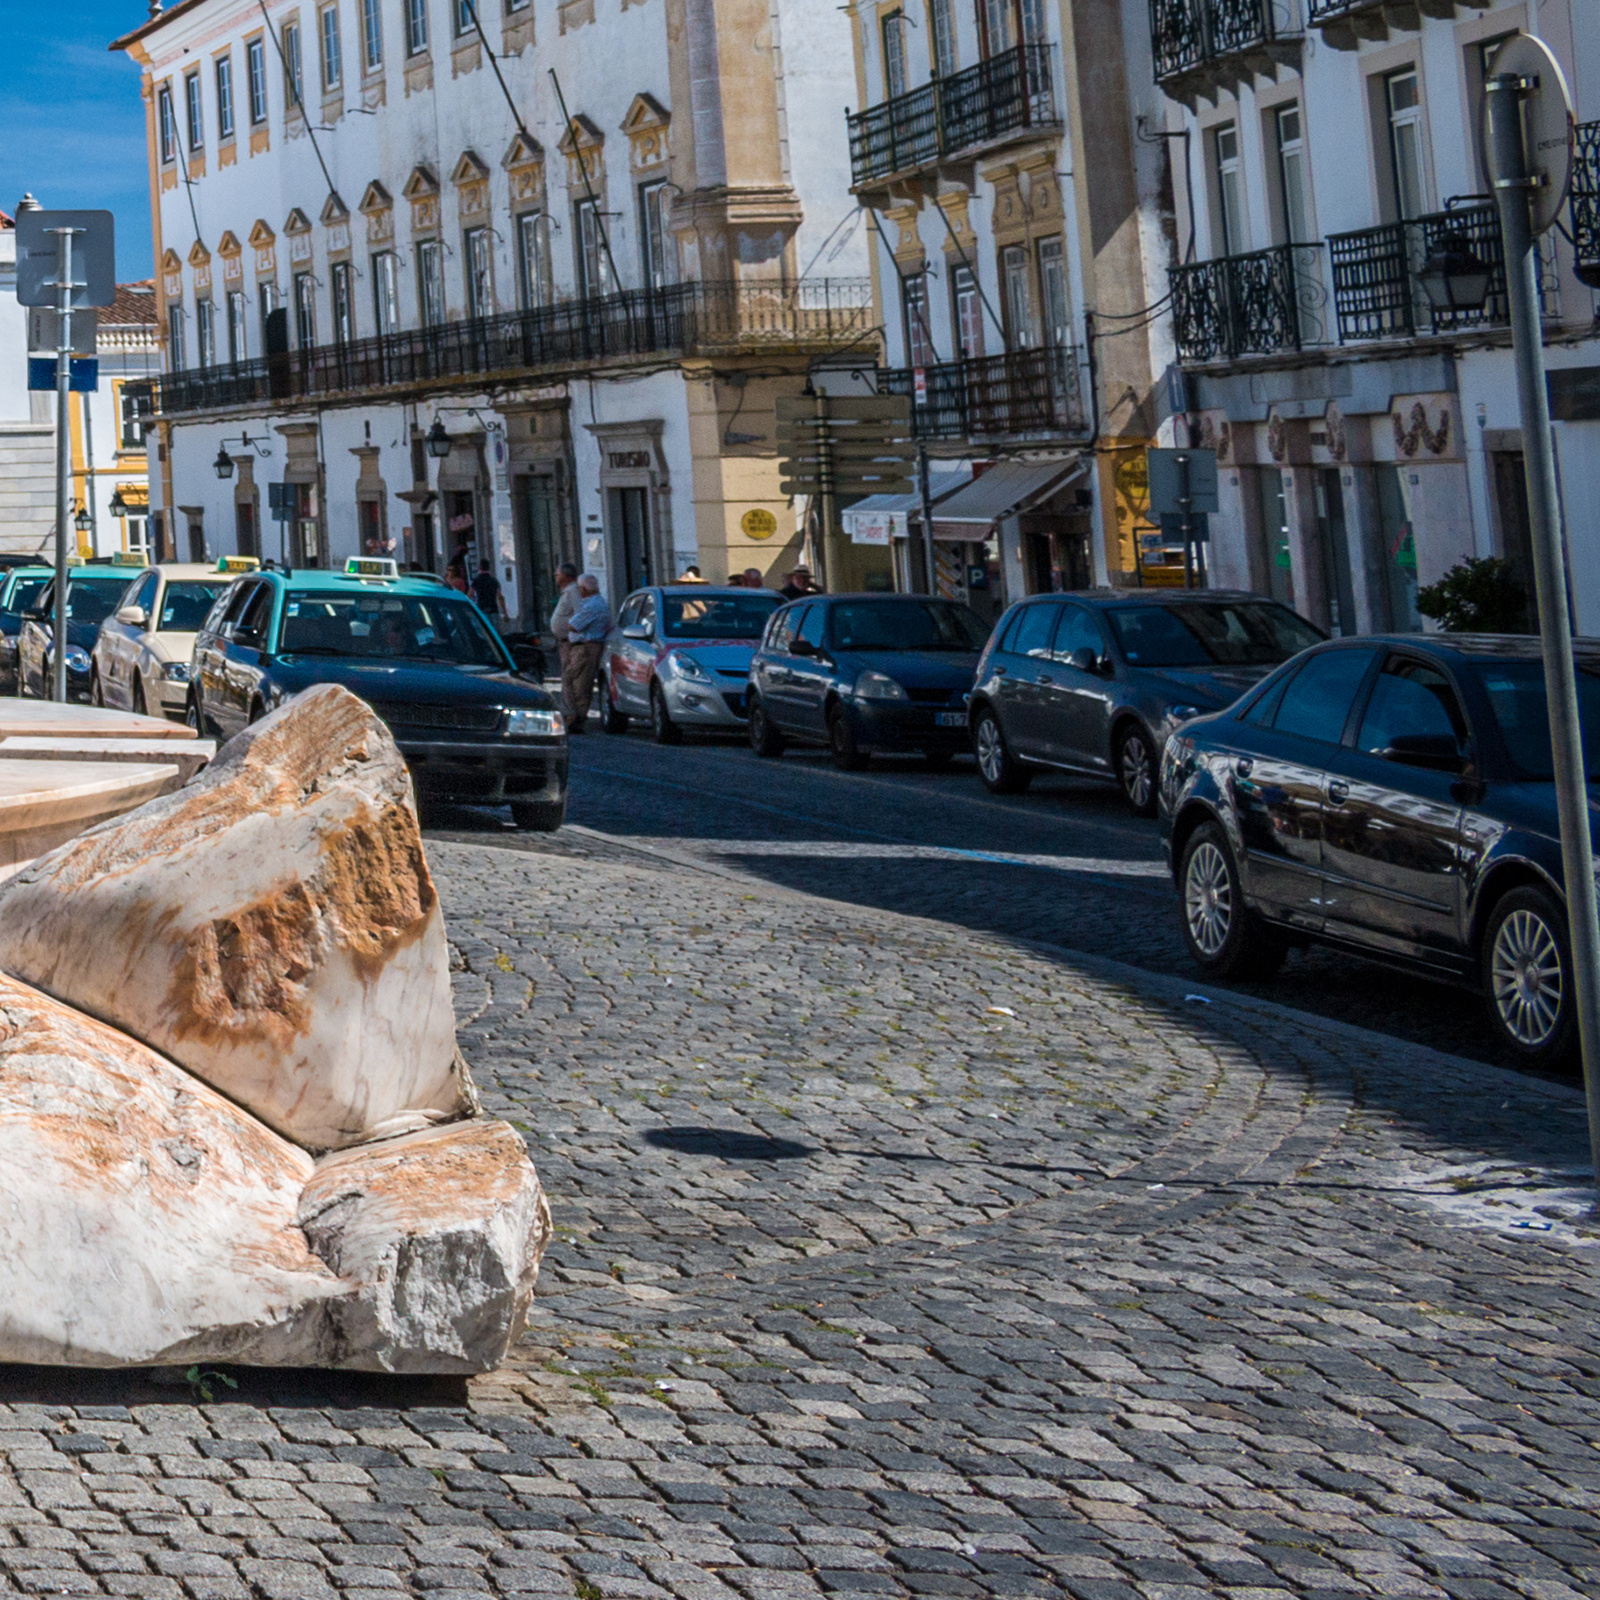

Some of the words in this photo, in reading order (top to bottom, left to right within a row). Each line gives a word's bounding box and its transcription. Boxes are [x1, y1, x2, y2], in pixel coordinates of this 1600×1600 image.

[608, 451, 651, 469] TURISMO
[228, 561, 247, 570] TAXI
[360, 562, 382, 574] TAXI
